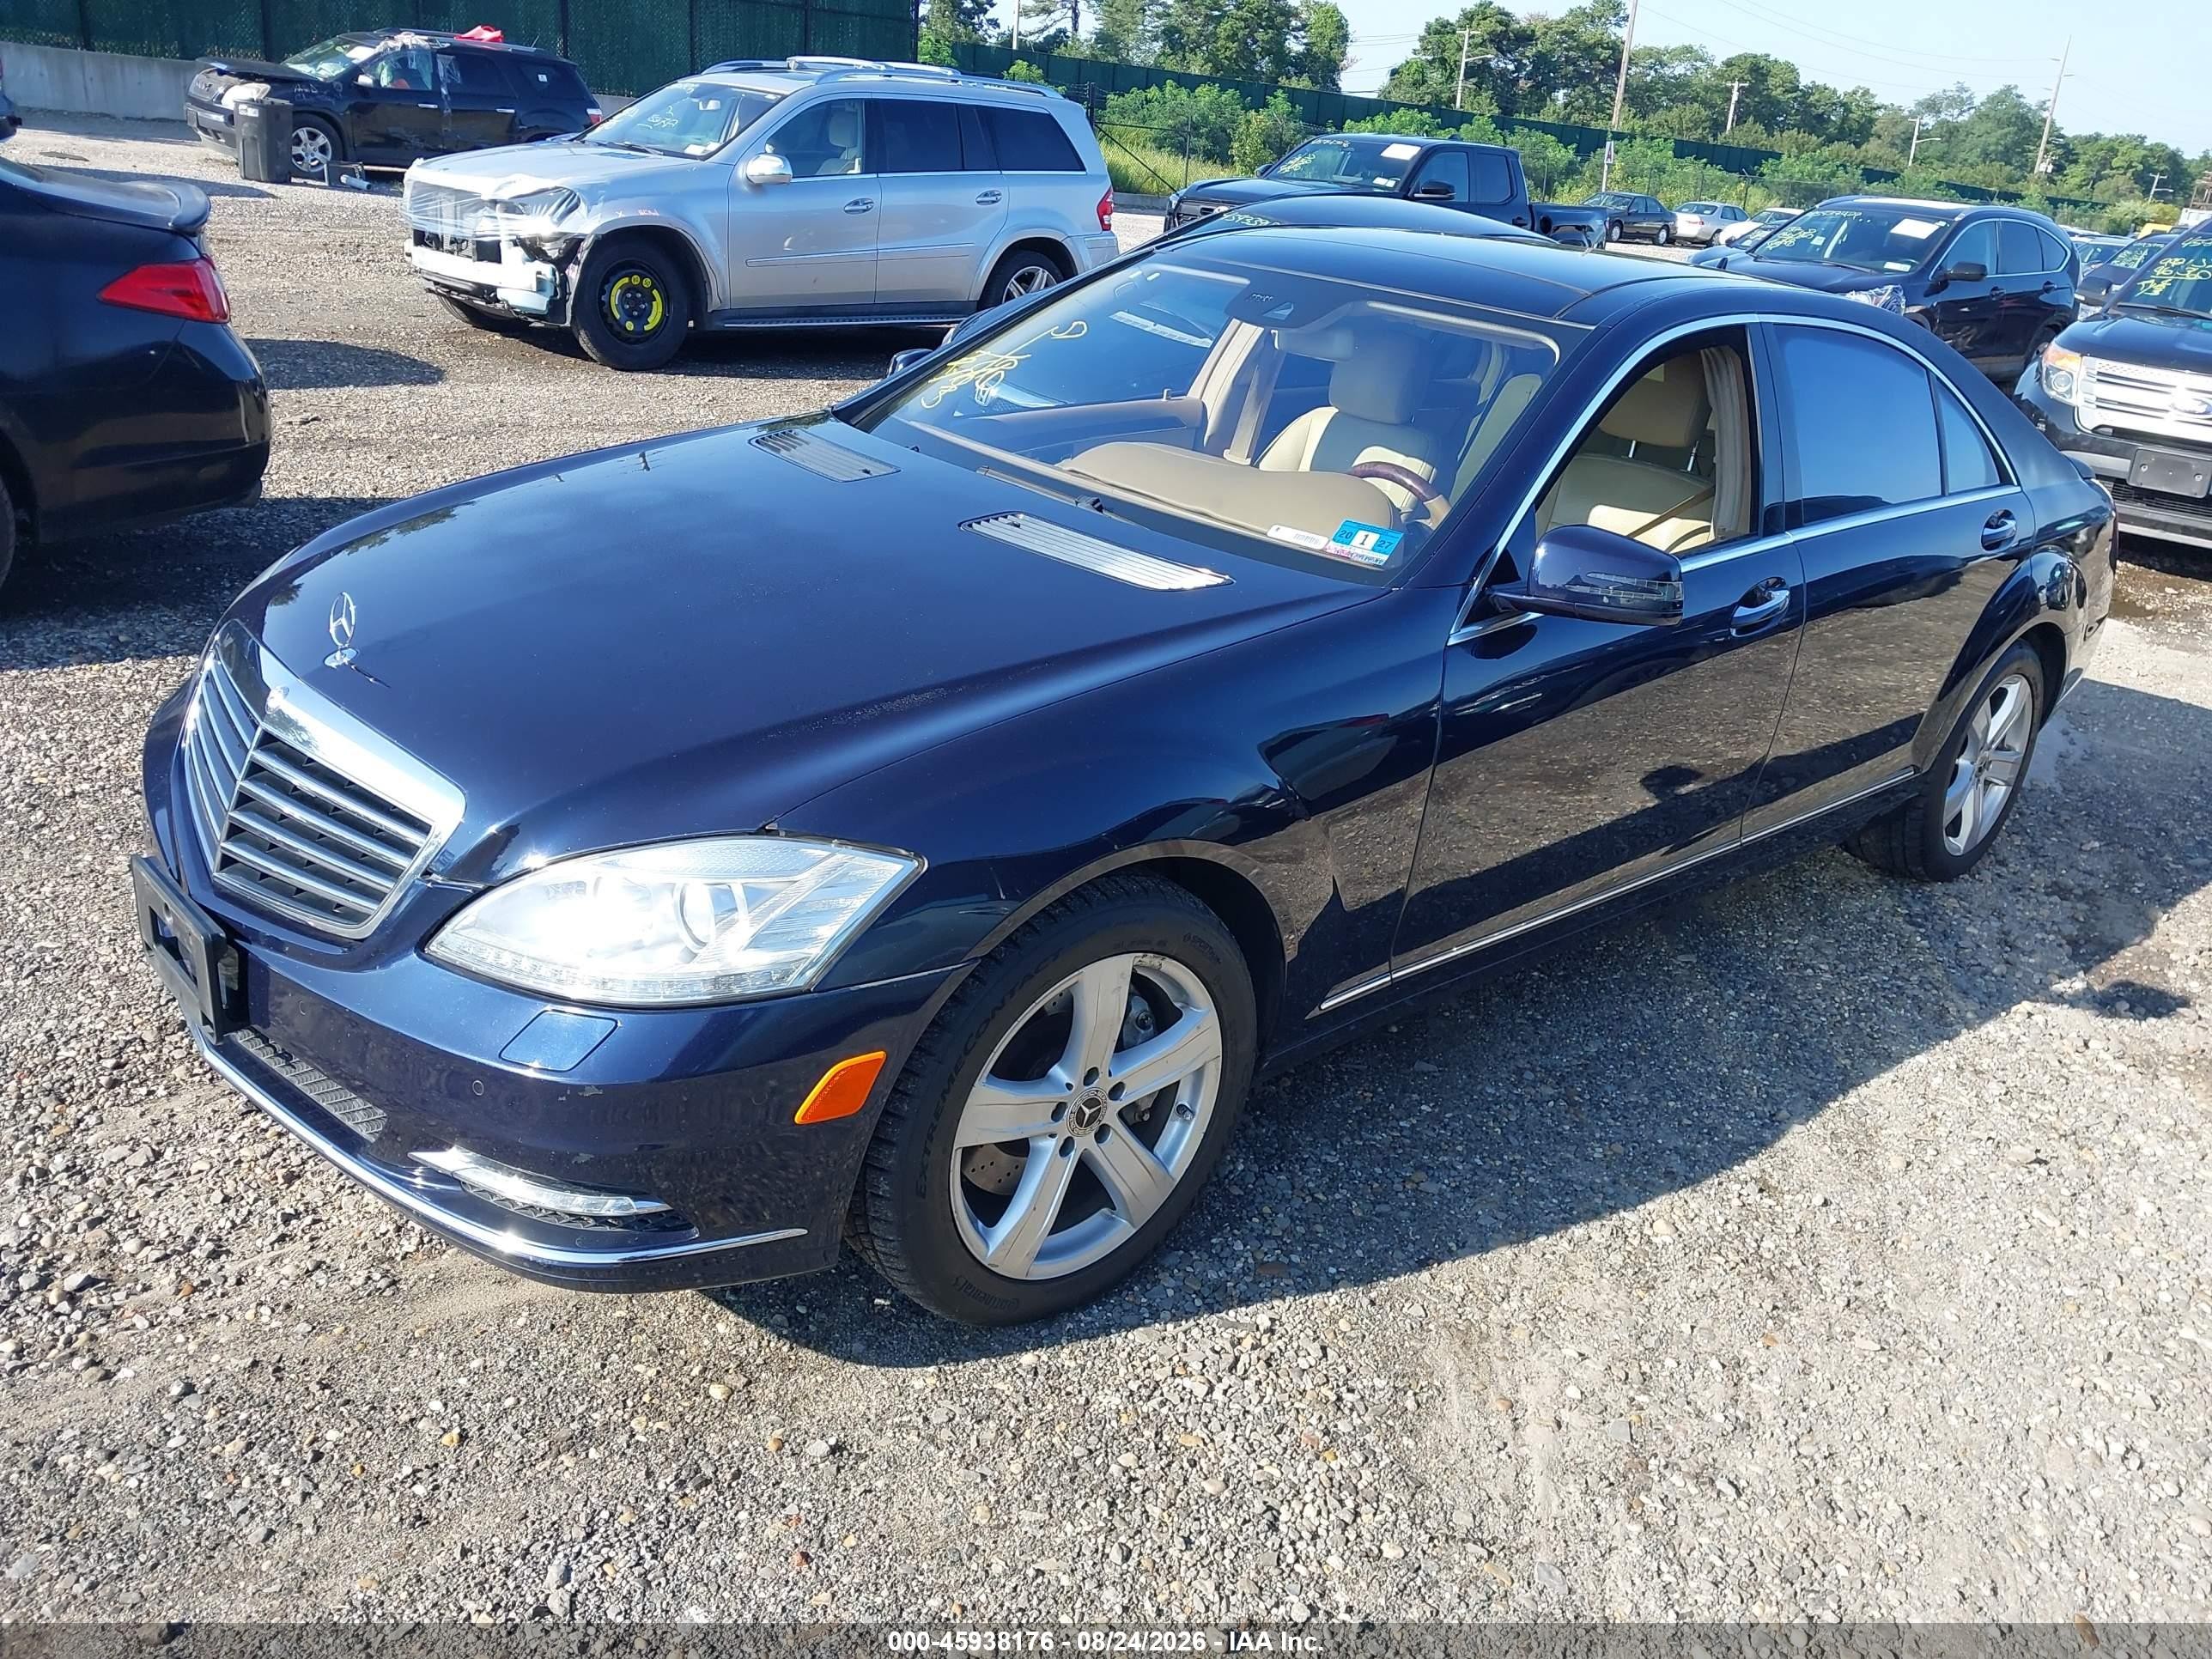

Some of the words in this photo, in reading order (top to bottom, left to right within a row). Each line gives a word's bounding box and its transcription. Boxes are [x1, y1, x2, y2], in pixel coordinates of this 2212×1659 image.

[1339, 530, 1352, 539] 20
[1359, 534, 1369, 545] 1
[1377, 539, 1393, 549] 27
